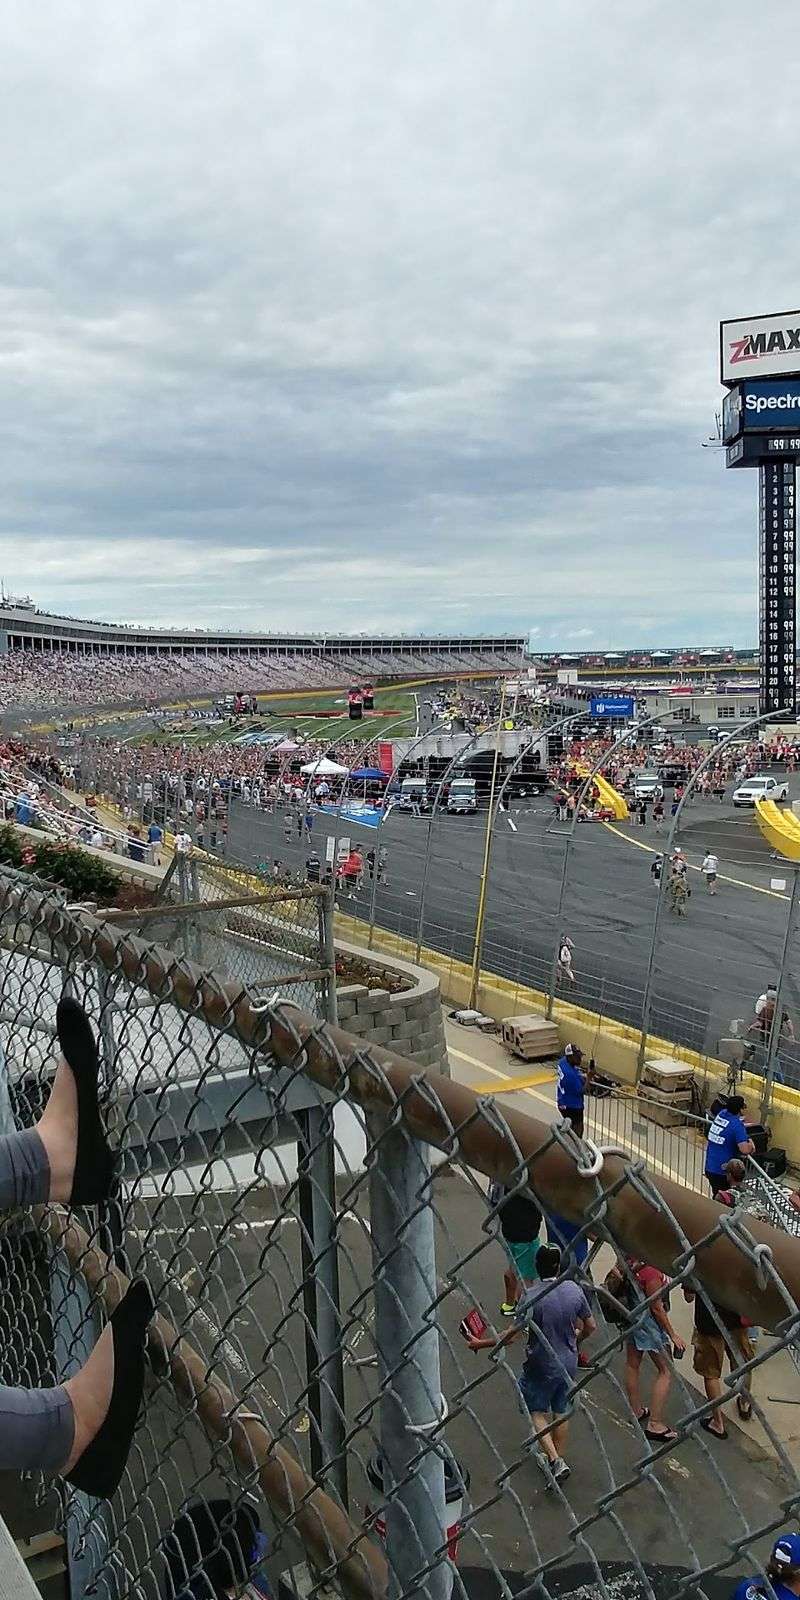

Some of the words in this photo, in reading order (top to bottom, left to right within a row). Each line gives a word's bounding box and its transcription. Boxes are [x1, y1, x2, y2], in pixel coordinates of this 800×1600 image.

[769, 565, 778, 573] 10
[769, 577, 778, 585] 11
[769, 588, 778, 596] 12
[769, 600, 778, 608] 13
[769, 610, 778, 618] 14
[769, 622, 778, 630] 15
[769, 632, 778, 640] 16
[769, 644, 778, 652] 17
[769, 655, 778, 663] 18
[769, 667, 778, 675] 19
[769, 677, 778, 685] 20
